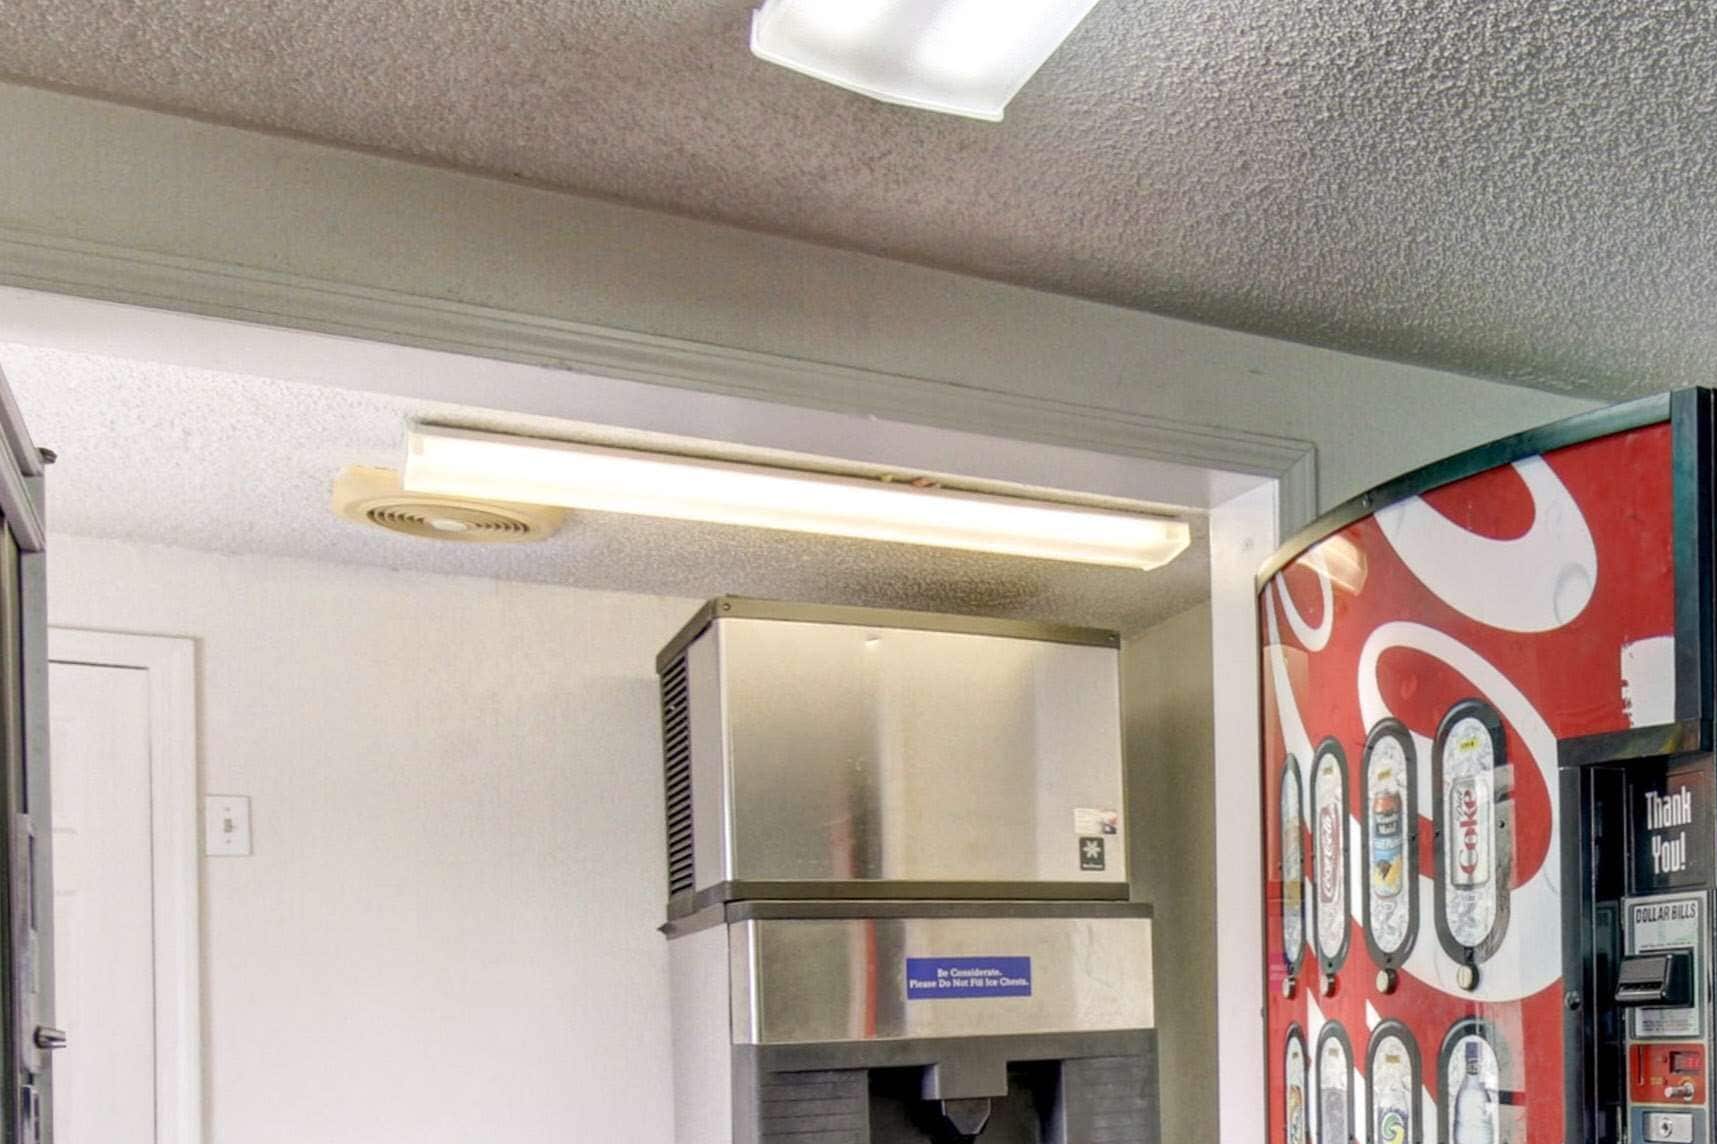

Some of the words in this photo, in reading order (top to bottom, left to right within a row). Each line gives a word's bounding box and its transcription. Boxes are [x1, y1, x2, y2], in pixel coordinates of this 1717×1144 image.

[1644, 785, 1692, 831] Thank
[1459, 788, 1478, 876] Coke
[1651, 831, 1687, 875] You!
[1635, 905, 1670, 924] DOLLAR
[1671, 902, 1697, 920] BILLS
[909, 979, 938, 990] Please
[939, 979, 952, 988] Do
[953, 978, 969, 987] Not
[970, 978, 984, 987] Fill
[985, 977, 998, 987] Ice
